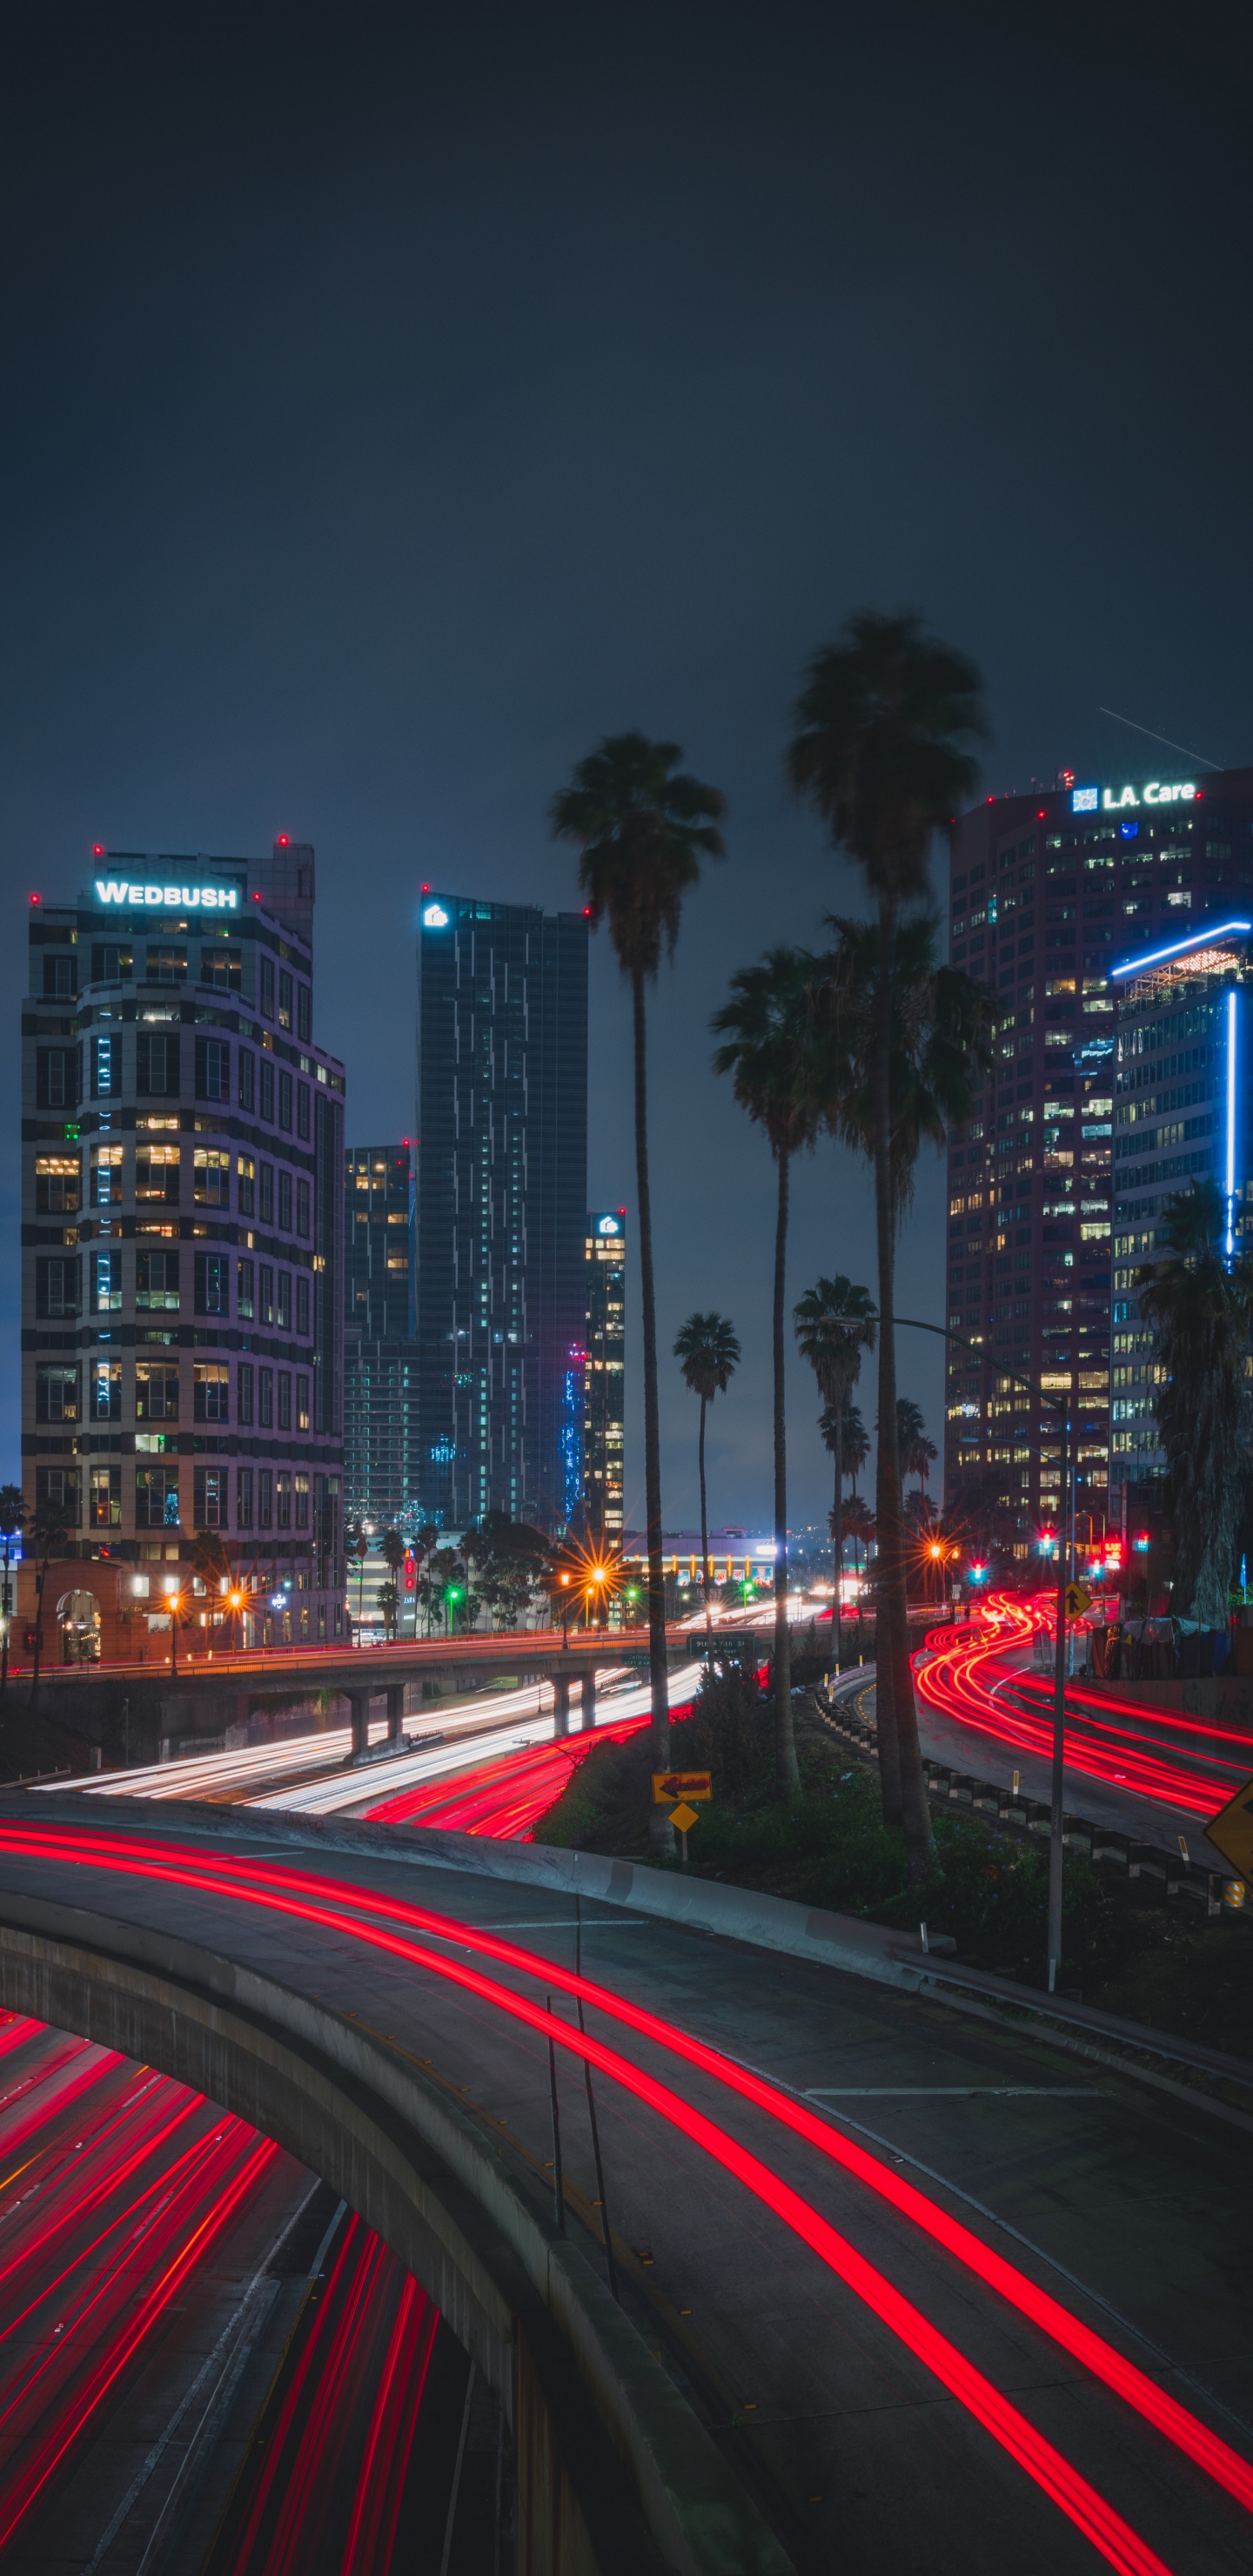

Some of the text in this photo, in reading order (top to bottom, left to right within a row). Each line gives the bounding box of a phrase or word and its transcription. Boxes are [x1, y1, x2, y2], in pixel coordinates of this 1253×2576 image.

[1103, 782, 1195, 808] L.A. Care
[96, 882, 236, 908] WEDBUSH
